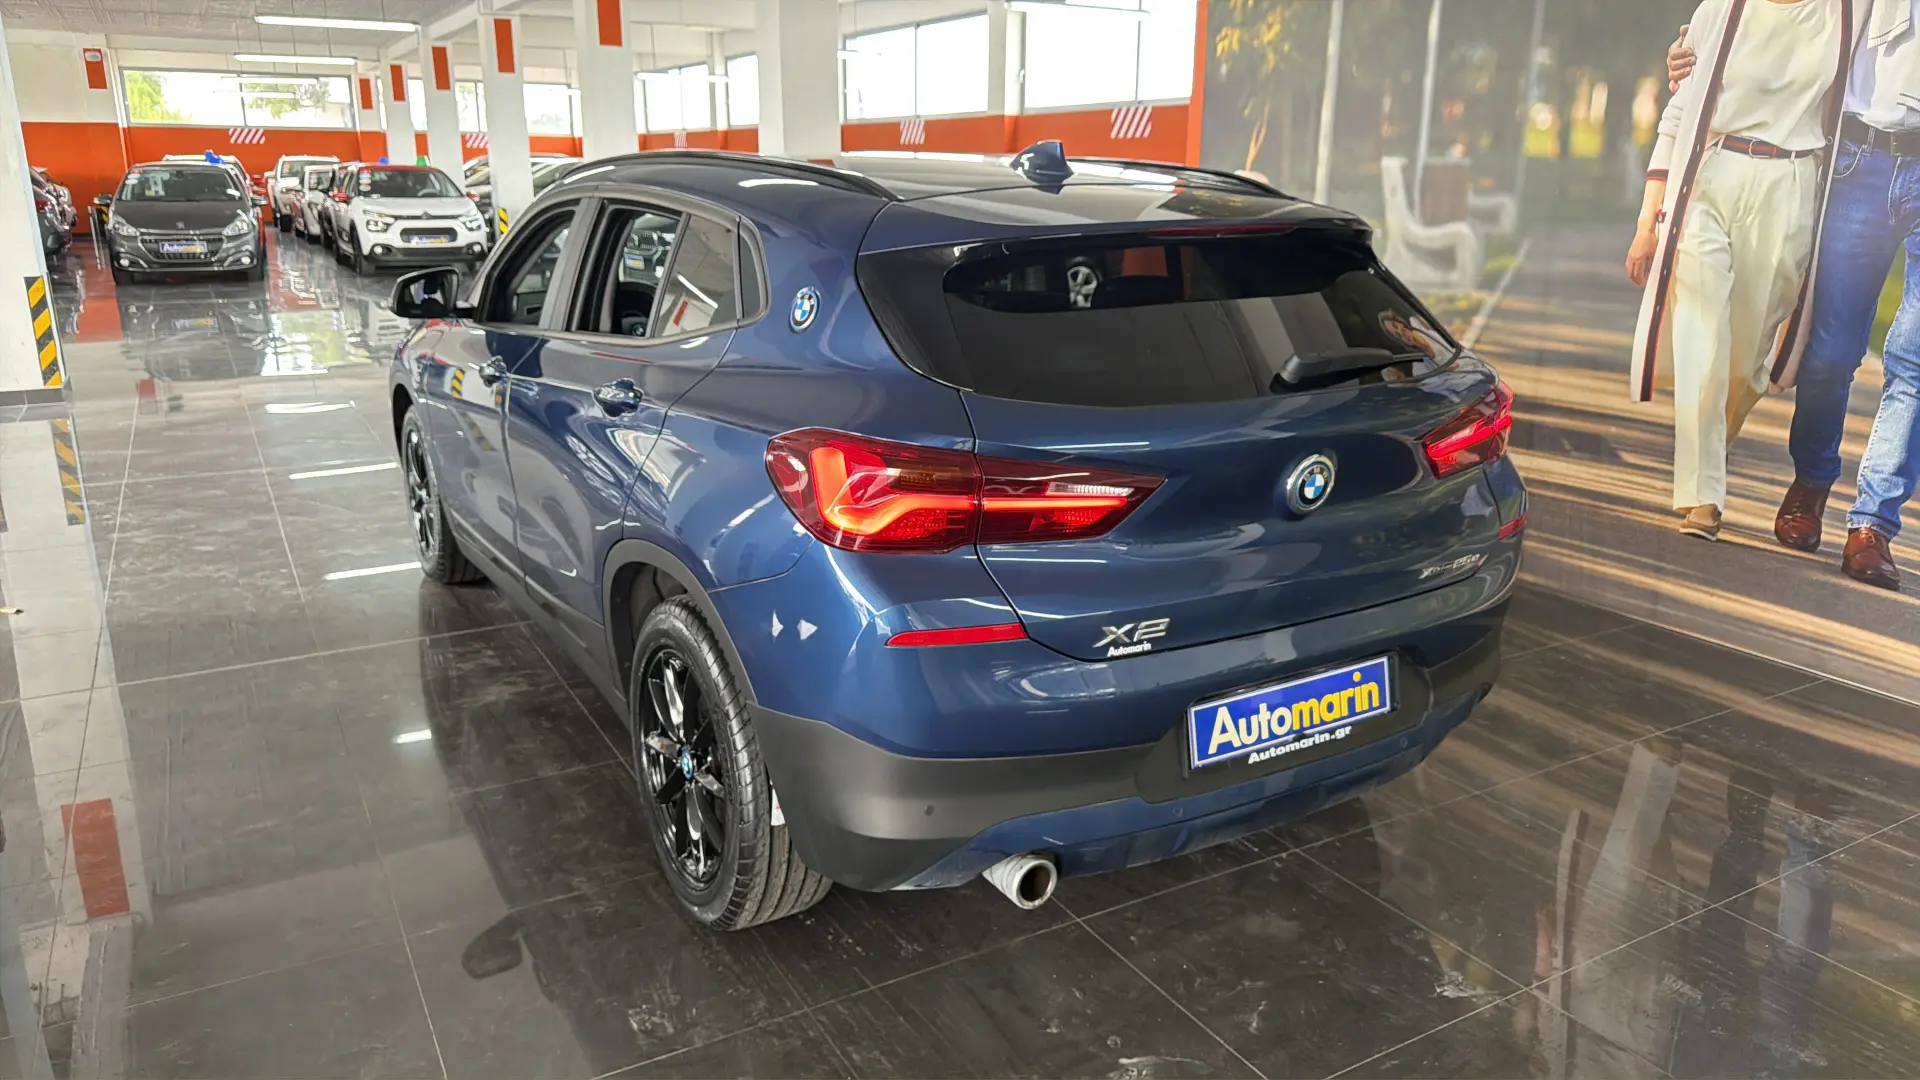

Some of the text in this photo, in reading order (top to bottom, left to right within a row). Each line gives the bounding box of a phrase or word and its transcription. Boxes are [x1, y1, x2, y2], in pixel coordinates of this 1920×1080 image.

[1092, 617, 1170, 648] X2
[1107, 641, 1152, 657] Automarin
[1207, 671, 1379, 755] Automarin
[1247, 725, 1352, 764] Automarin.gr
